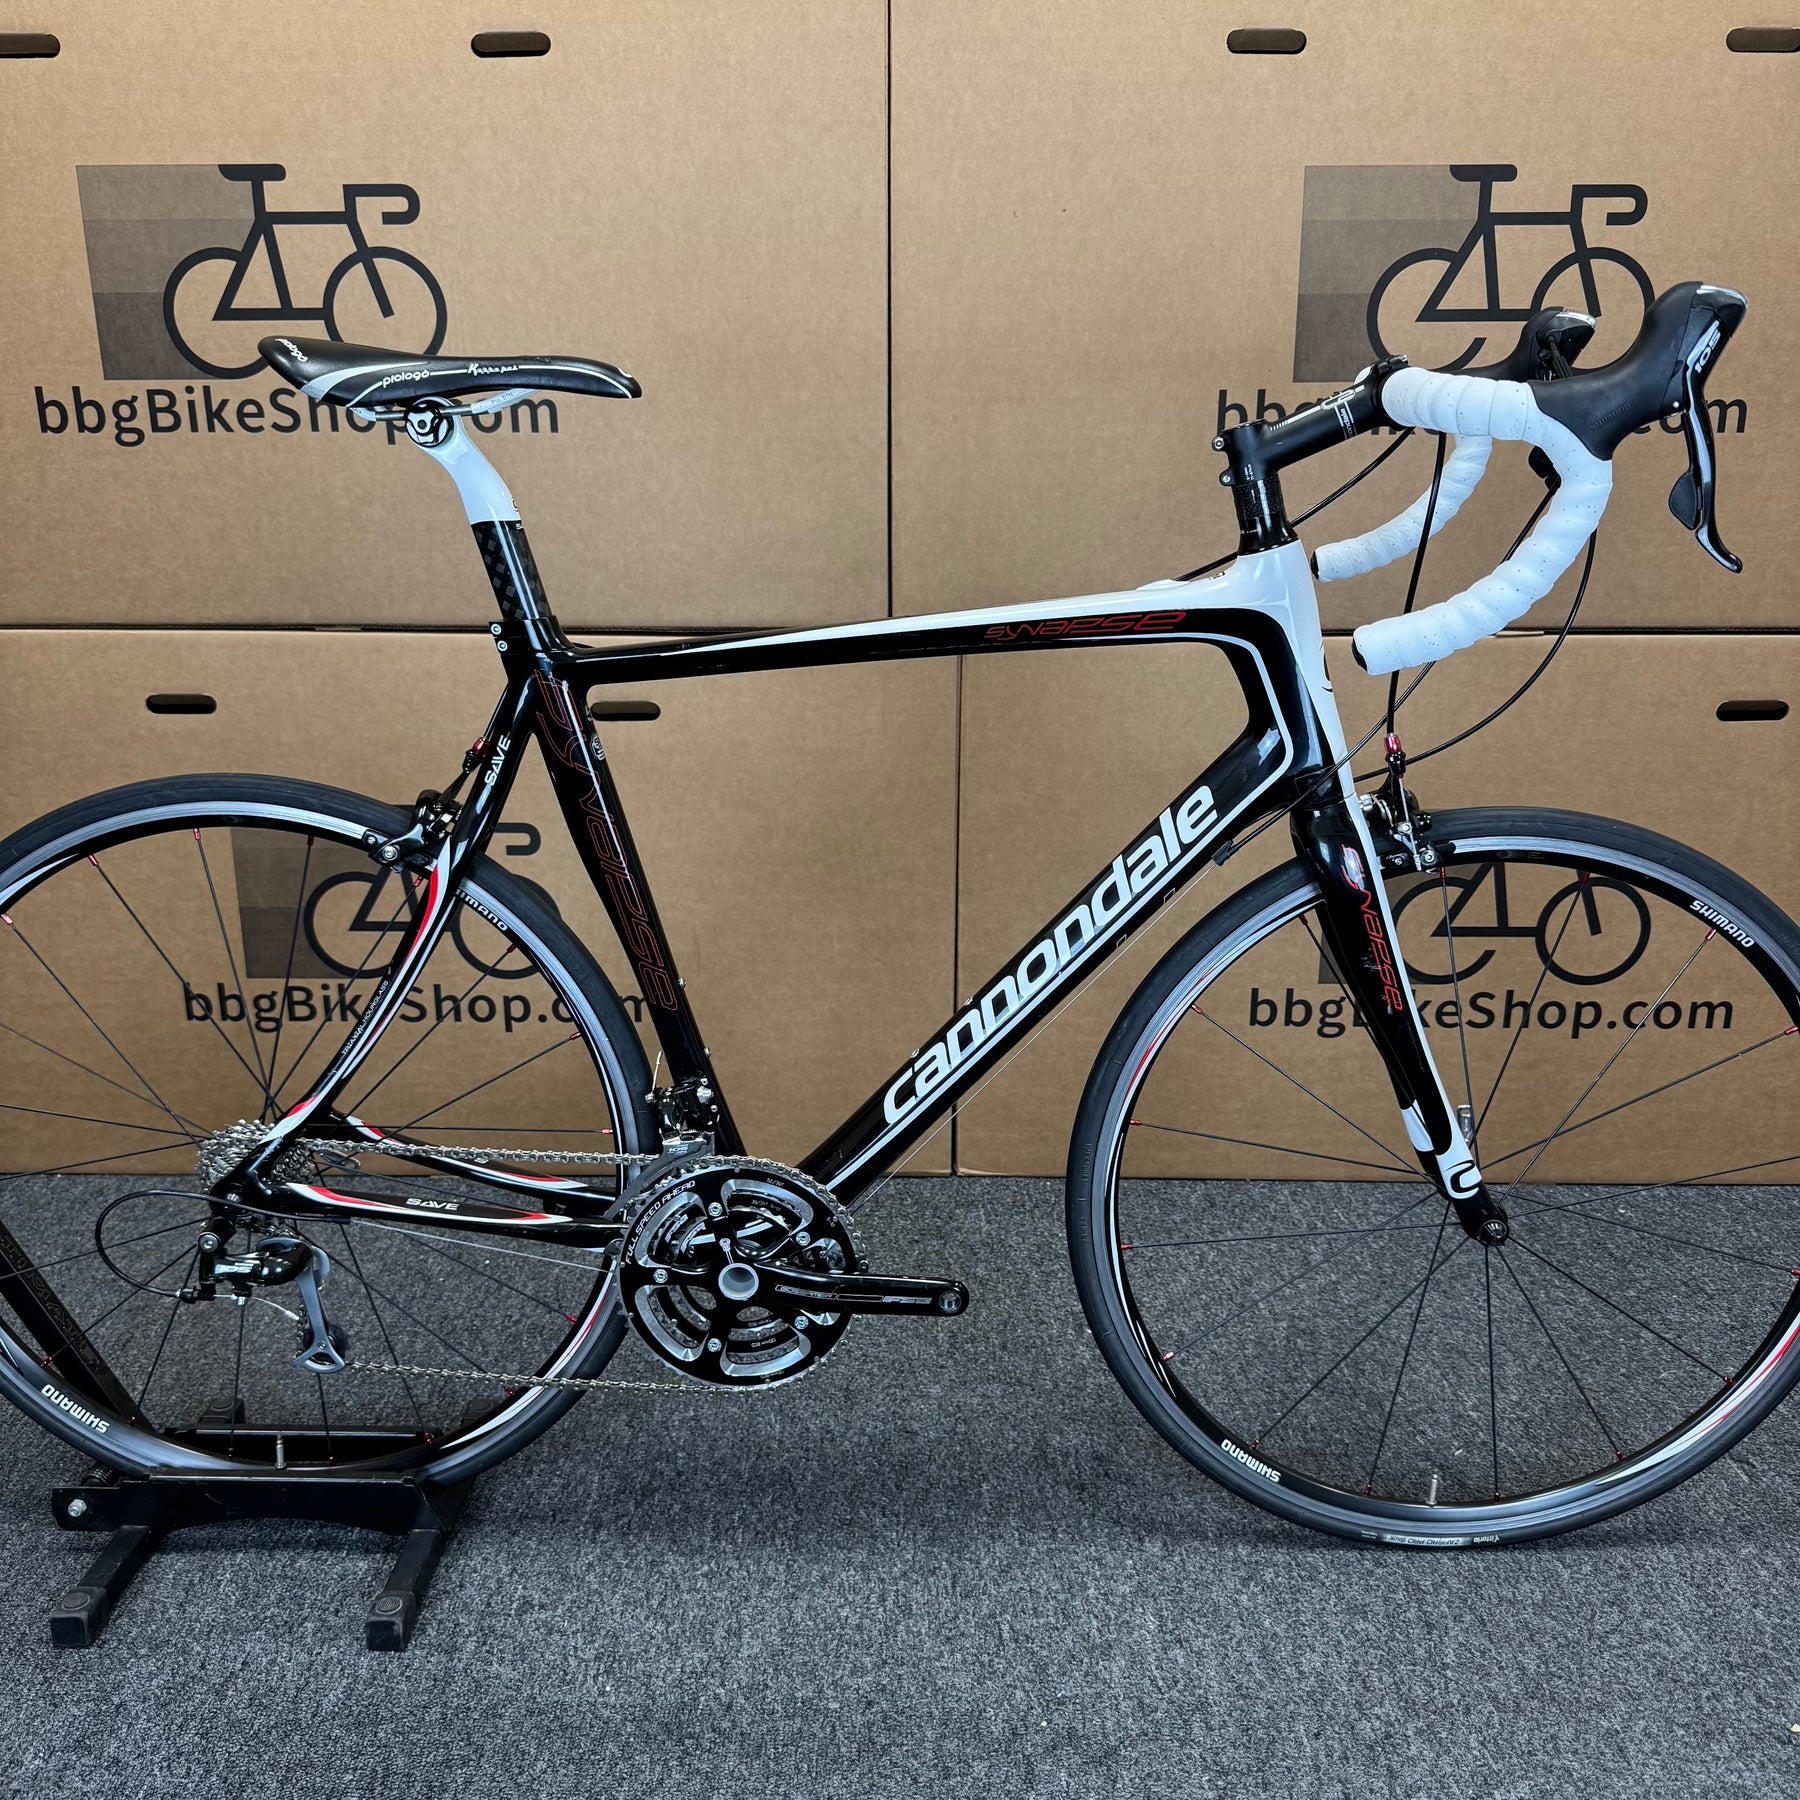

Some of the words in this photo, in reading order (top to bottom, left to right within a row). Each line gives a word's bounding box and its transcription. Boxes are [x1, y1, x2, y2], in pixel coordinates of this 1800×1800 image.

[381, 369, 431, 388] prologo
[38, 386, 559, 447] bbgBikeShoom
[484, 734, 511, 786] SAVE
[456, 888, 508, 931] IMANO
[1689, 899, 1755, 948] SHIMANO
[883, 785, 1219, 1125] cannondale
[1249, 988, 1733, 1040] bbgkeShop.com
[406, 1197, 460, 1211] SAVE
[625, 1236, 639, 1265] FULL
[635, 1201, 661, 1236] SPEED
[661, 1180, 696, 1204] AHEAD
[41, 1383, 110, 1434] SHIMANO
[1220, 1438, 1282, 1484] SHIMANO
[1473, 1534, 1500, 1543] Vittoria
